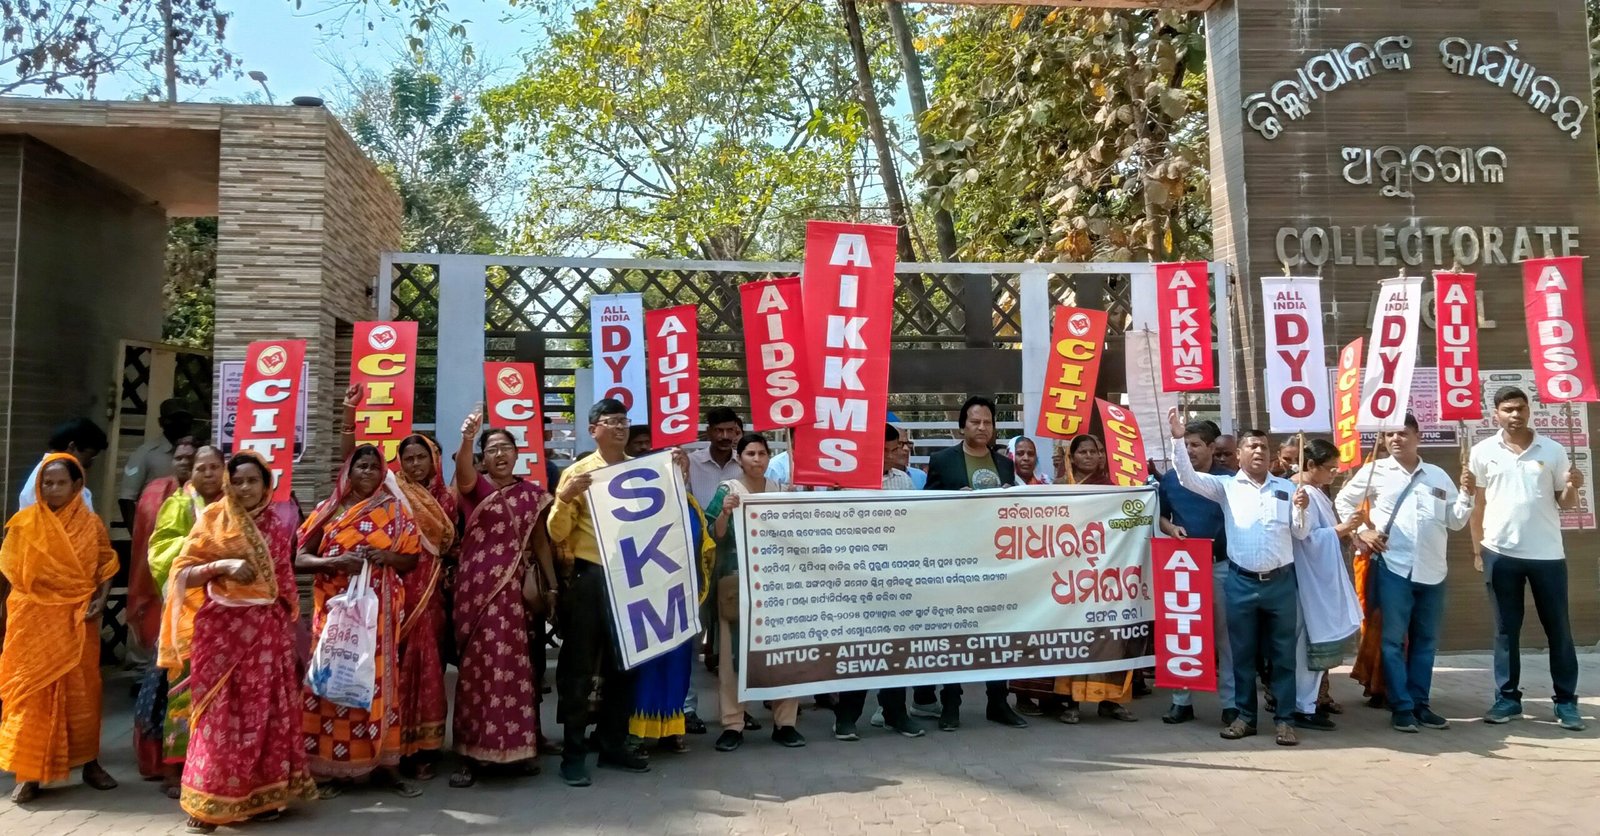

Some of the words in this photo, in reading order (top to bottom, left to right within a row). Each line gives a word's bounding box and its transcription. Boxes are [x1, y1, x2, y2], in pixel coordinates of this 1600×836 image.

[1341, 144, 1508, 198] ଅନୁଗୋଳ
[601, 314, 630, 322] INDIA
[604, 306, 627, 314] ALL
[1168, 270, 1203, 384] AIKKMS
[1273, 302, 1307, 310] INDIA
[1276, 291, 1302, 300] ALL
[1384, 303, 1409, 311] INDIA
[1389, 292, 1408, 301] ALL
[756, 285, 804, 425] AIDSO
[814, 233, 872, 472] AIKKMS
[1274, 313, 1316, 418] DYO
[1370, 315, 1407, 419] DYO
[1442, 283, 1473, 408] AIUTUC
[1535, 265, 1583, 399] AIDSO
[657, 315, 690, 435] AIUTUC
[1045, 338, 1096, 435] CITU
[495, 398, 539, 486] CIT
[1338, 367, 1356, 464] CITU
[857, 510, 870, 518] ଶ୍ରମ
[994, 522, 1106, 560] ସାଧାରଣ
[998, 503, 1070, 519] ସର୍ବଭାରତୀୟ
[607, 467, 689, 653] SKM
[766, 648, 820, 666] INTUC
[836, 642, 894, 659] AITUC
[910, 639, 950, 653] HMS
[966, 635, 1010, 649] CITU
[1027, 631, 1095, 646] AIUTUC
[1110, 624, 1150, 640] TUCC
[1085, 610, 1118, 622] ସଫଳ
[1163, 550, 1204, 678] AIUTUC
[836, 655, 890, 674] SEWA
[904, 654, 974, 669] AICCTU
[991, 650, 1024, 664] LPF
[1040, 646, 1090, 660] UTUC
